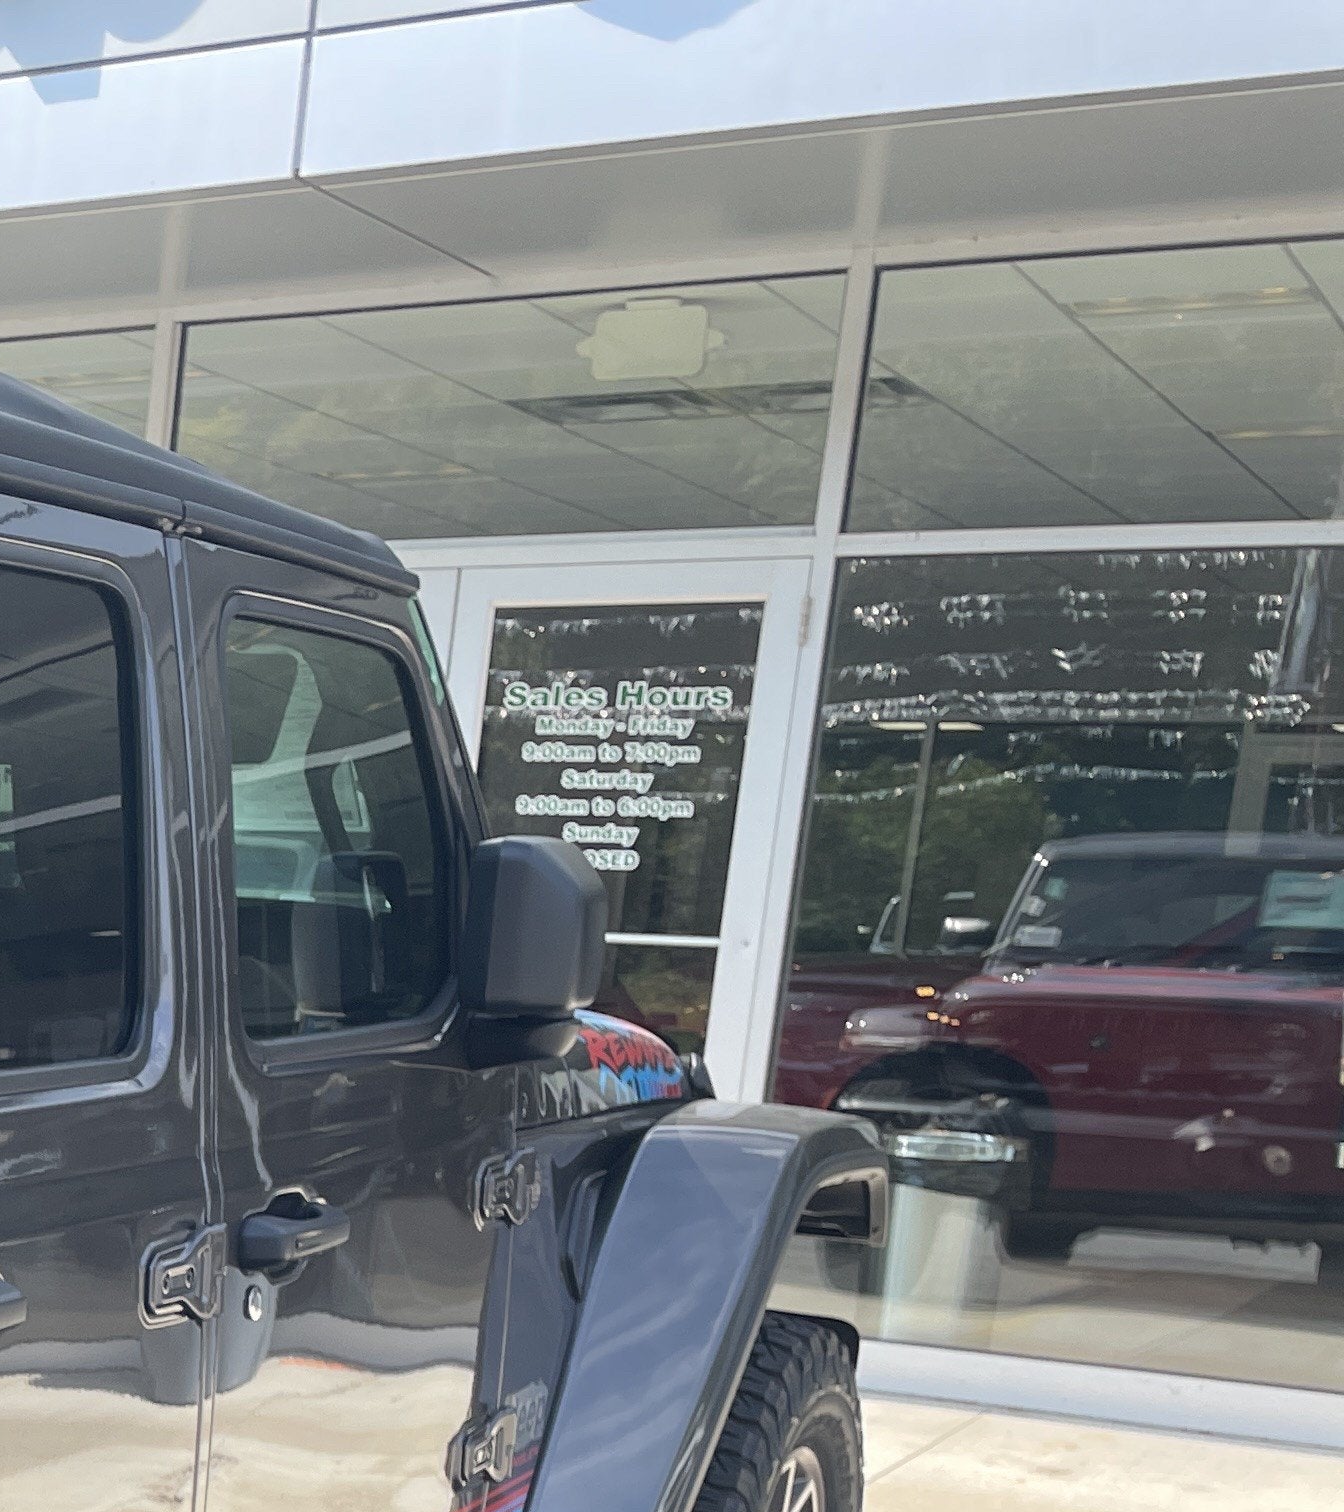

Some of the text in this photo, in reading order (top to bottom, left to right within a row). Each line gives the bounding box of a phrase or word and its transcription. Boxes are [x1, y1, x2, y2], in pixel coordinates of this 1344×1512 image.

[504, 680, 733, 711] Sales Hours
[535, 714, 614, 739] Monday
[627, 714, 695, 739] Friday
[521, 741, 596, 763] 9:00am
[597, 742, 623, 763] to
[560, 768, 654, 794] Saturday
[515, 794, 590, 816] 9:00am
[591, 796, 616, 817] to
[562, 822, 640, 847] Sunday
